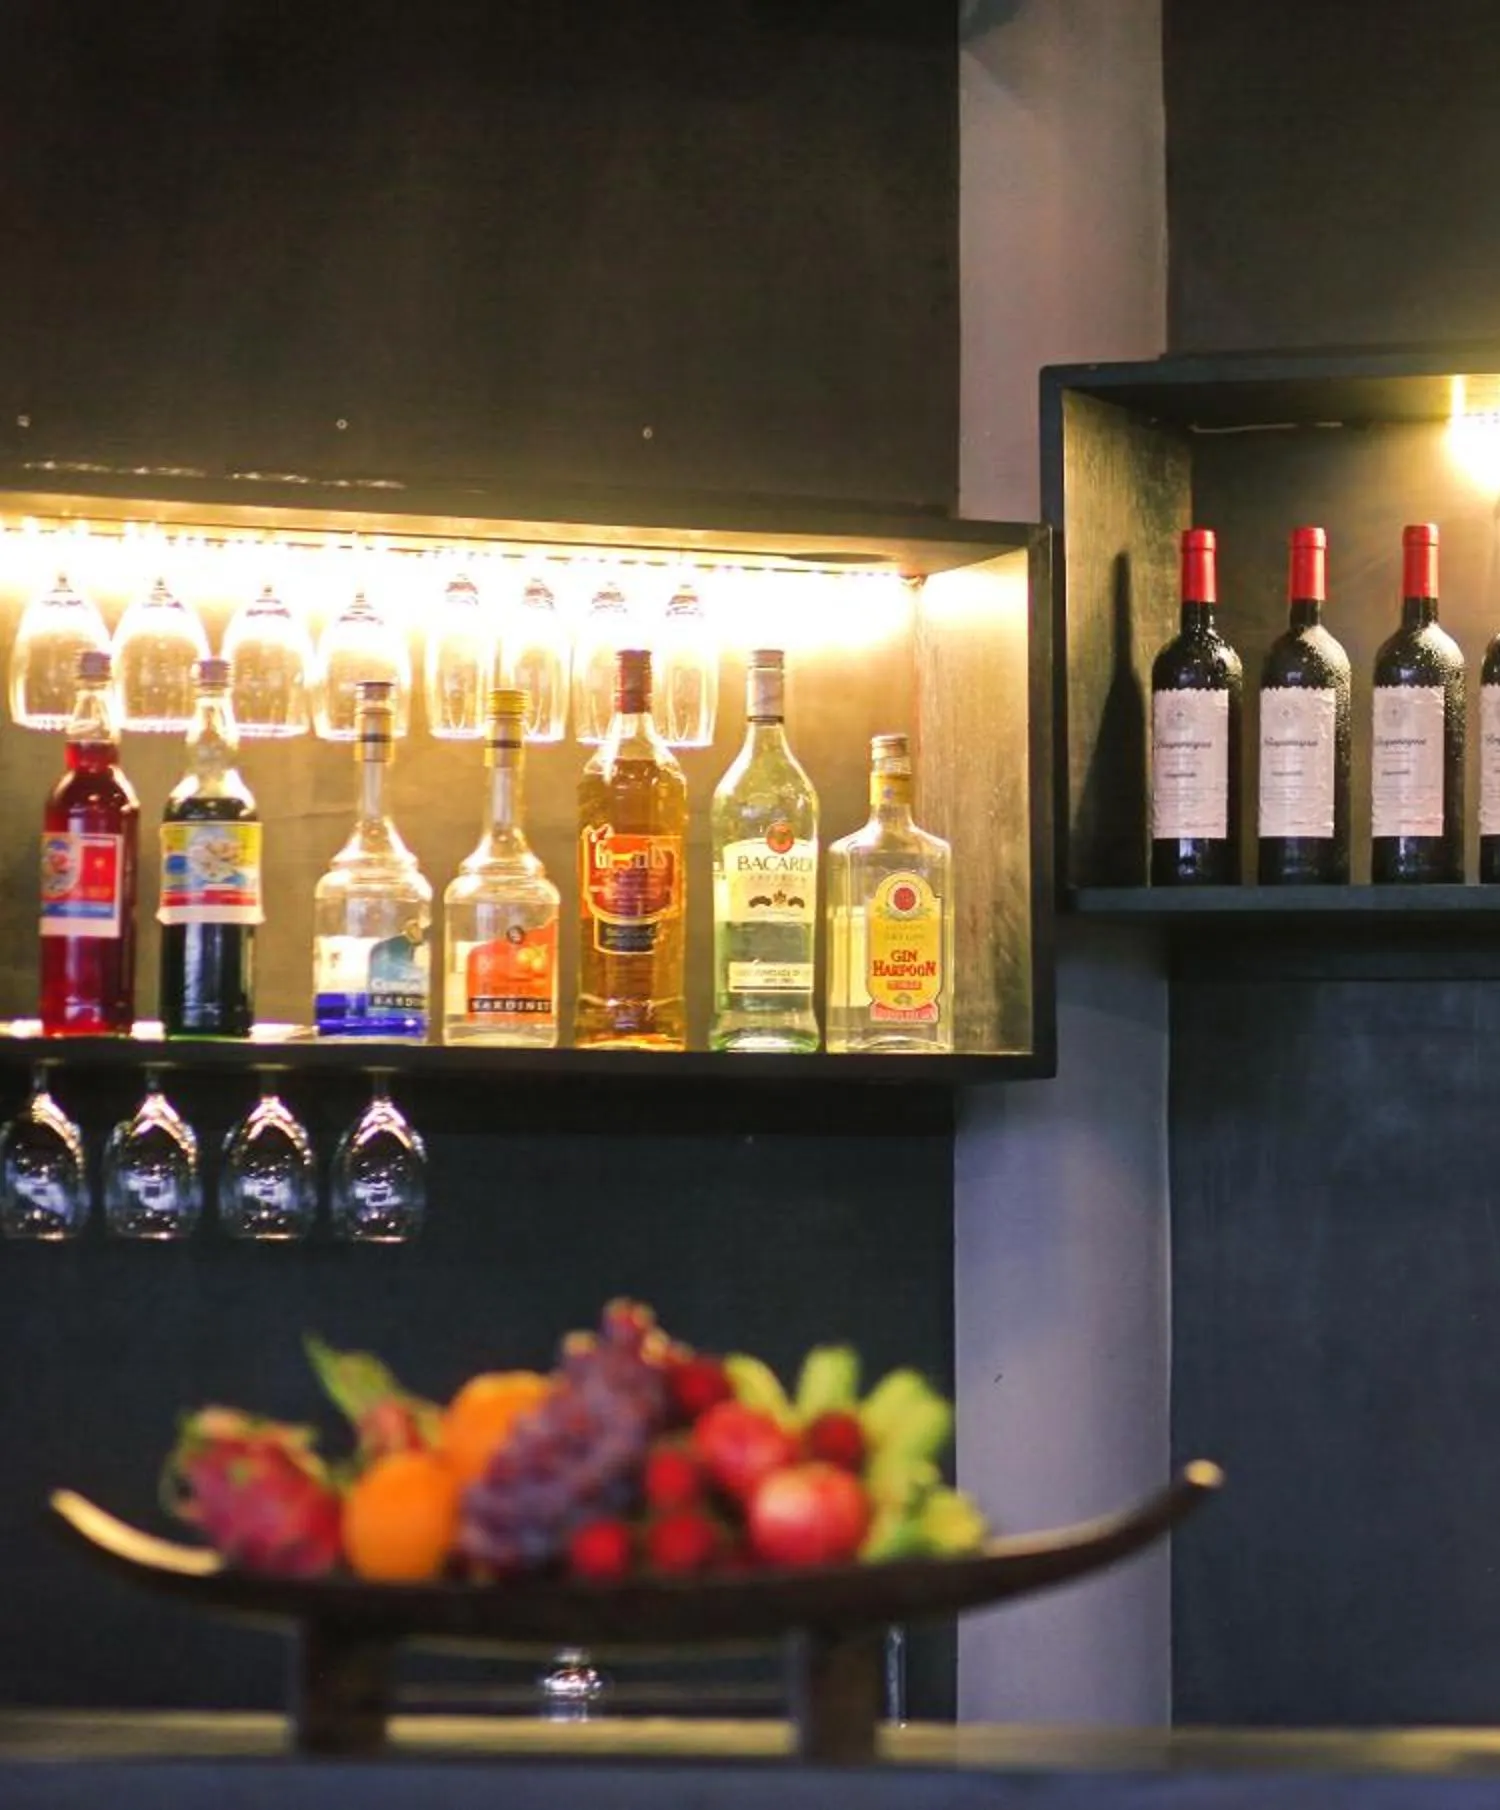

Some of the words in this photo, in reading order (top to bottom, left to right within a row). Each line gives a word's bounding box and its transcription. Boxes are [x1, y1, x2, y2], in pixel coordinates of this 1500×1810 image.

[737, 855, 813, 872] BACARDI
[890, 949, 918, 962] GIN
[872, 959, 937, 977] HARPOON
